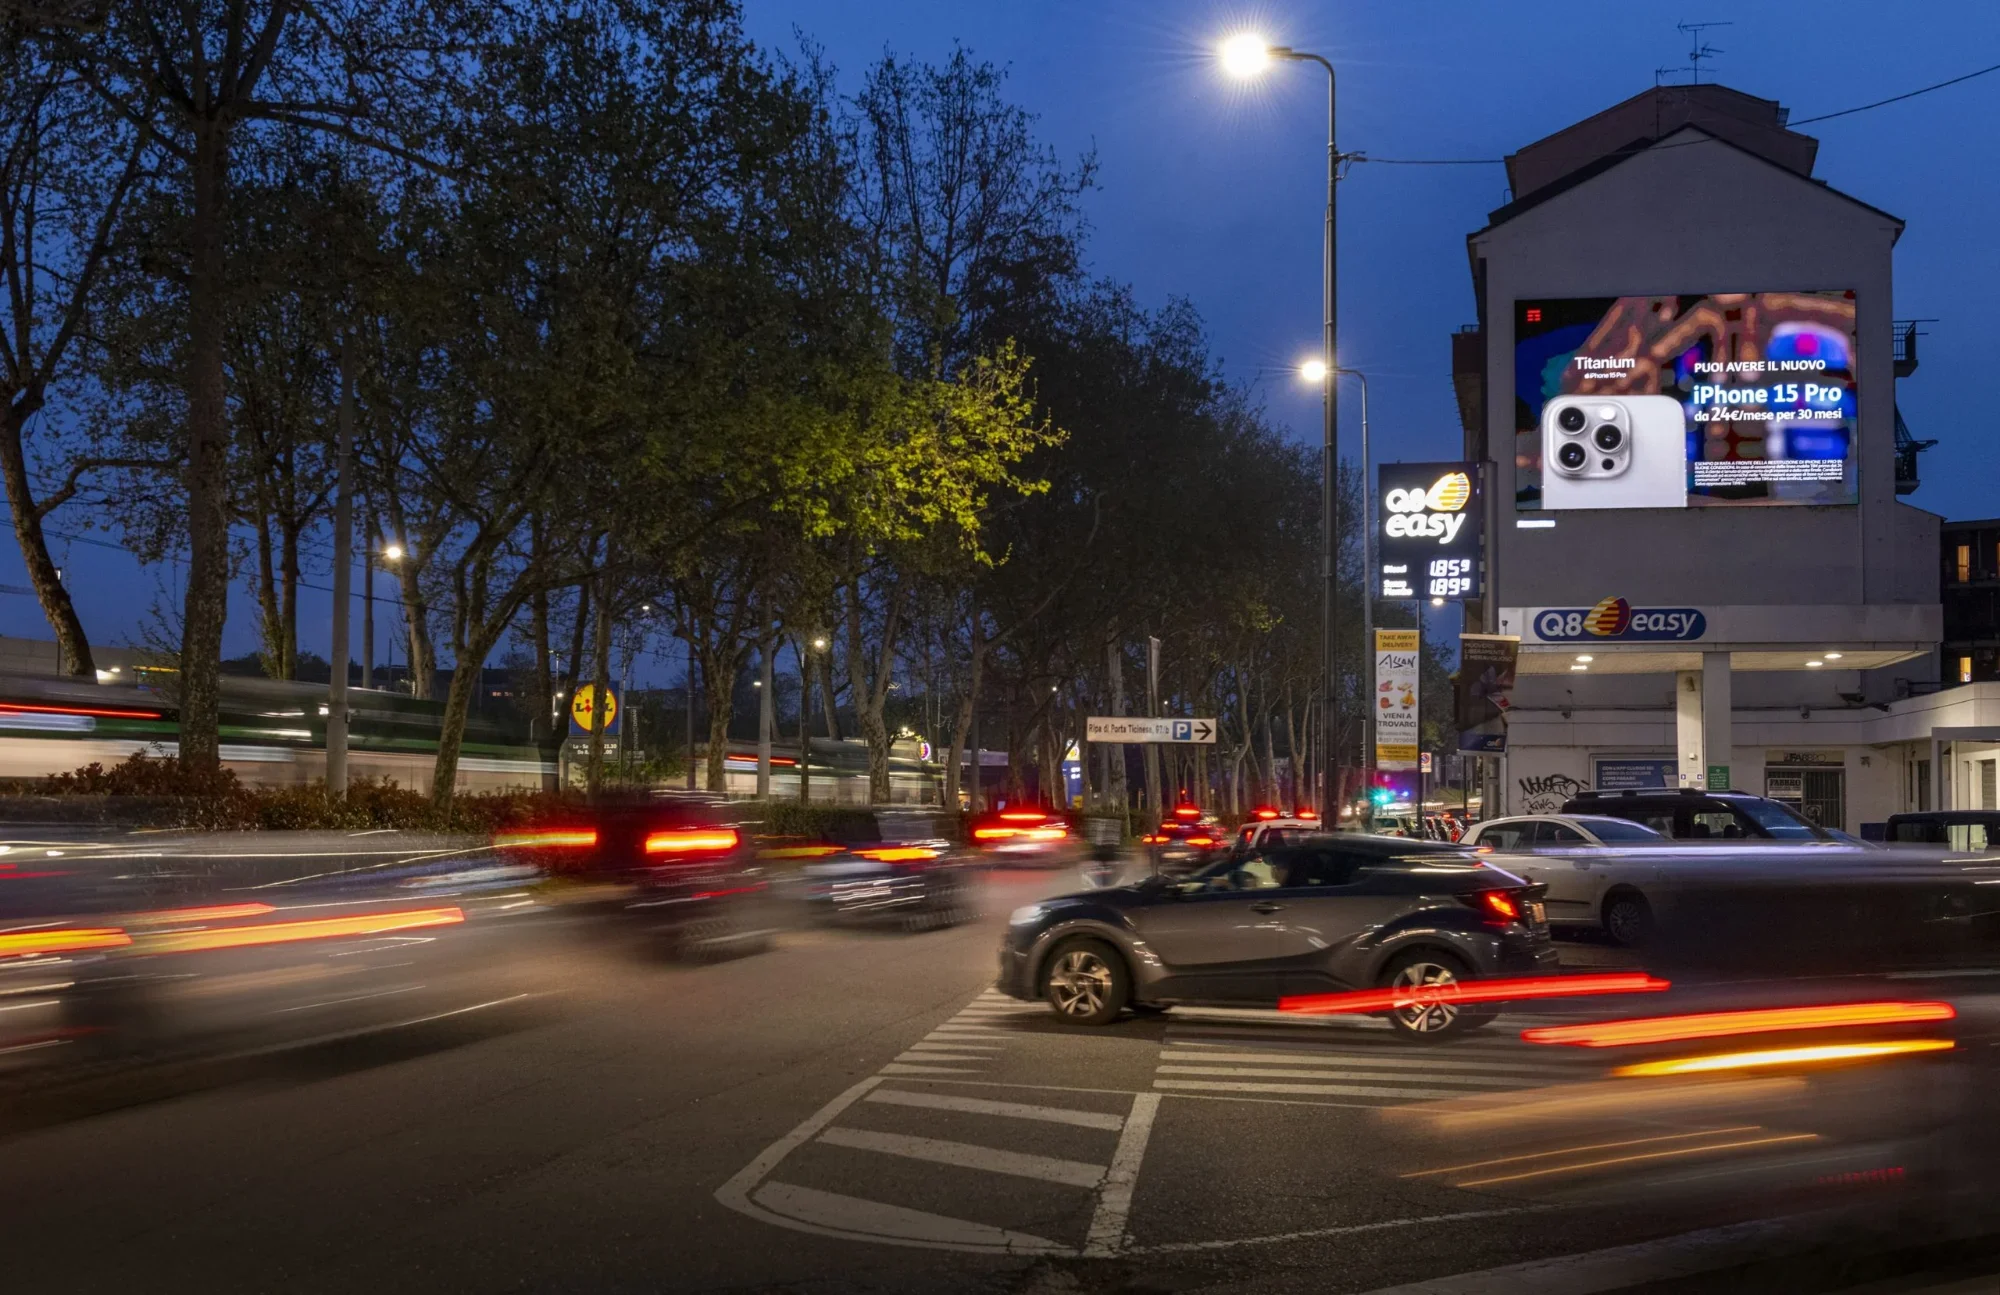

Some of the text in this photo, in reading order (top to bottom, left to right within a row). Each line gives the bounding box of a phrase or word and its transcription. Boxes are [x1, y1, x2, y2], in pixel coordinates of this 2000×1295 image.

[1574, 355, 1635, 370] Titanium
[1694, 360, 1826, 373] PUOI AVERE IL NUOVO
[1693, 383, 1842, 405] iPhone 15 Pro
[1694, 407, 1842, 423] da 24€/mese per 30 mesi
[1385, 488, 1427, 513] Q8
[1385, 513, 1467, 544] easy
[1540, 612, 1698, 638] Q8 easy
[1378, 654, 1417, 669] ASIAN
[1089, 724, 1102, 734] Ripa
[1103, 724, 1109, 733] di
[1111, 724, 1126, 733] Porta
[1176, 723, 1188, 738] P
